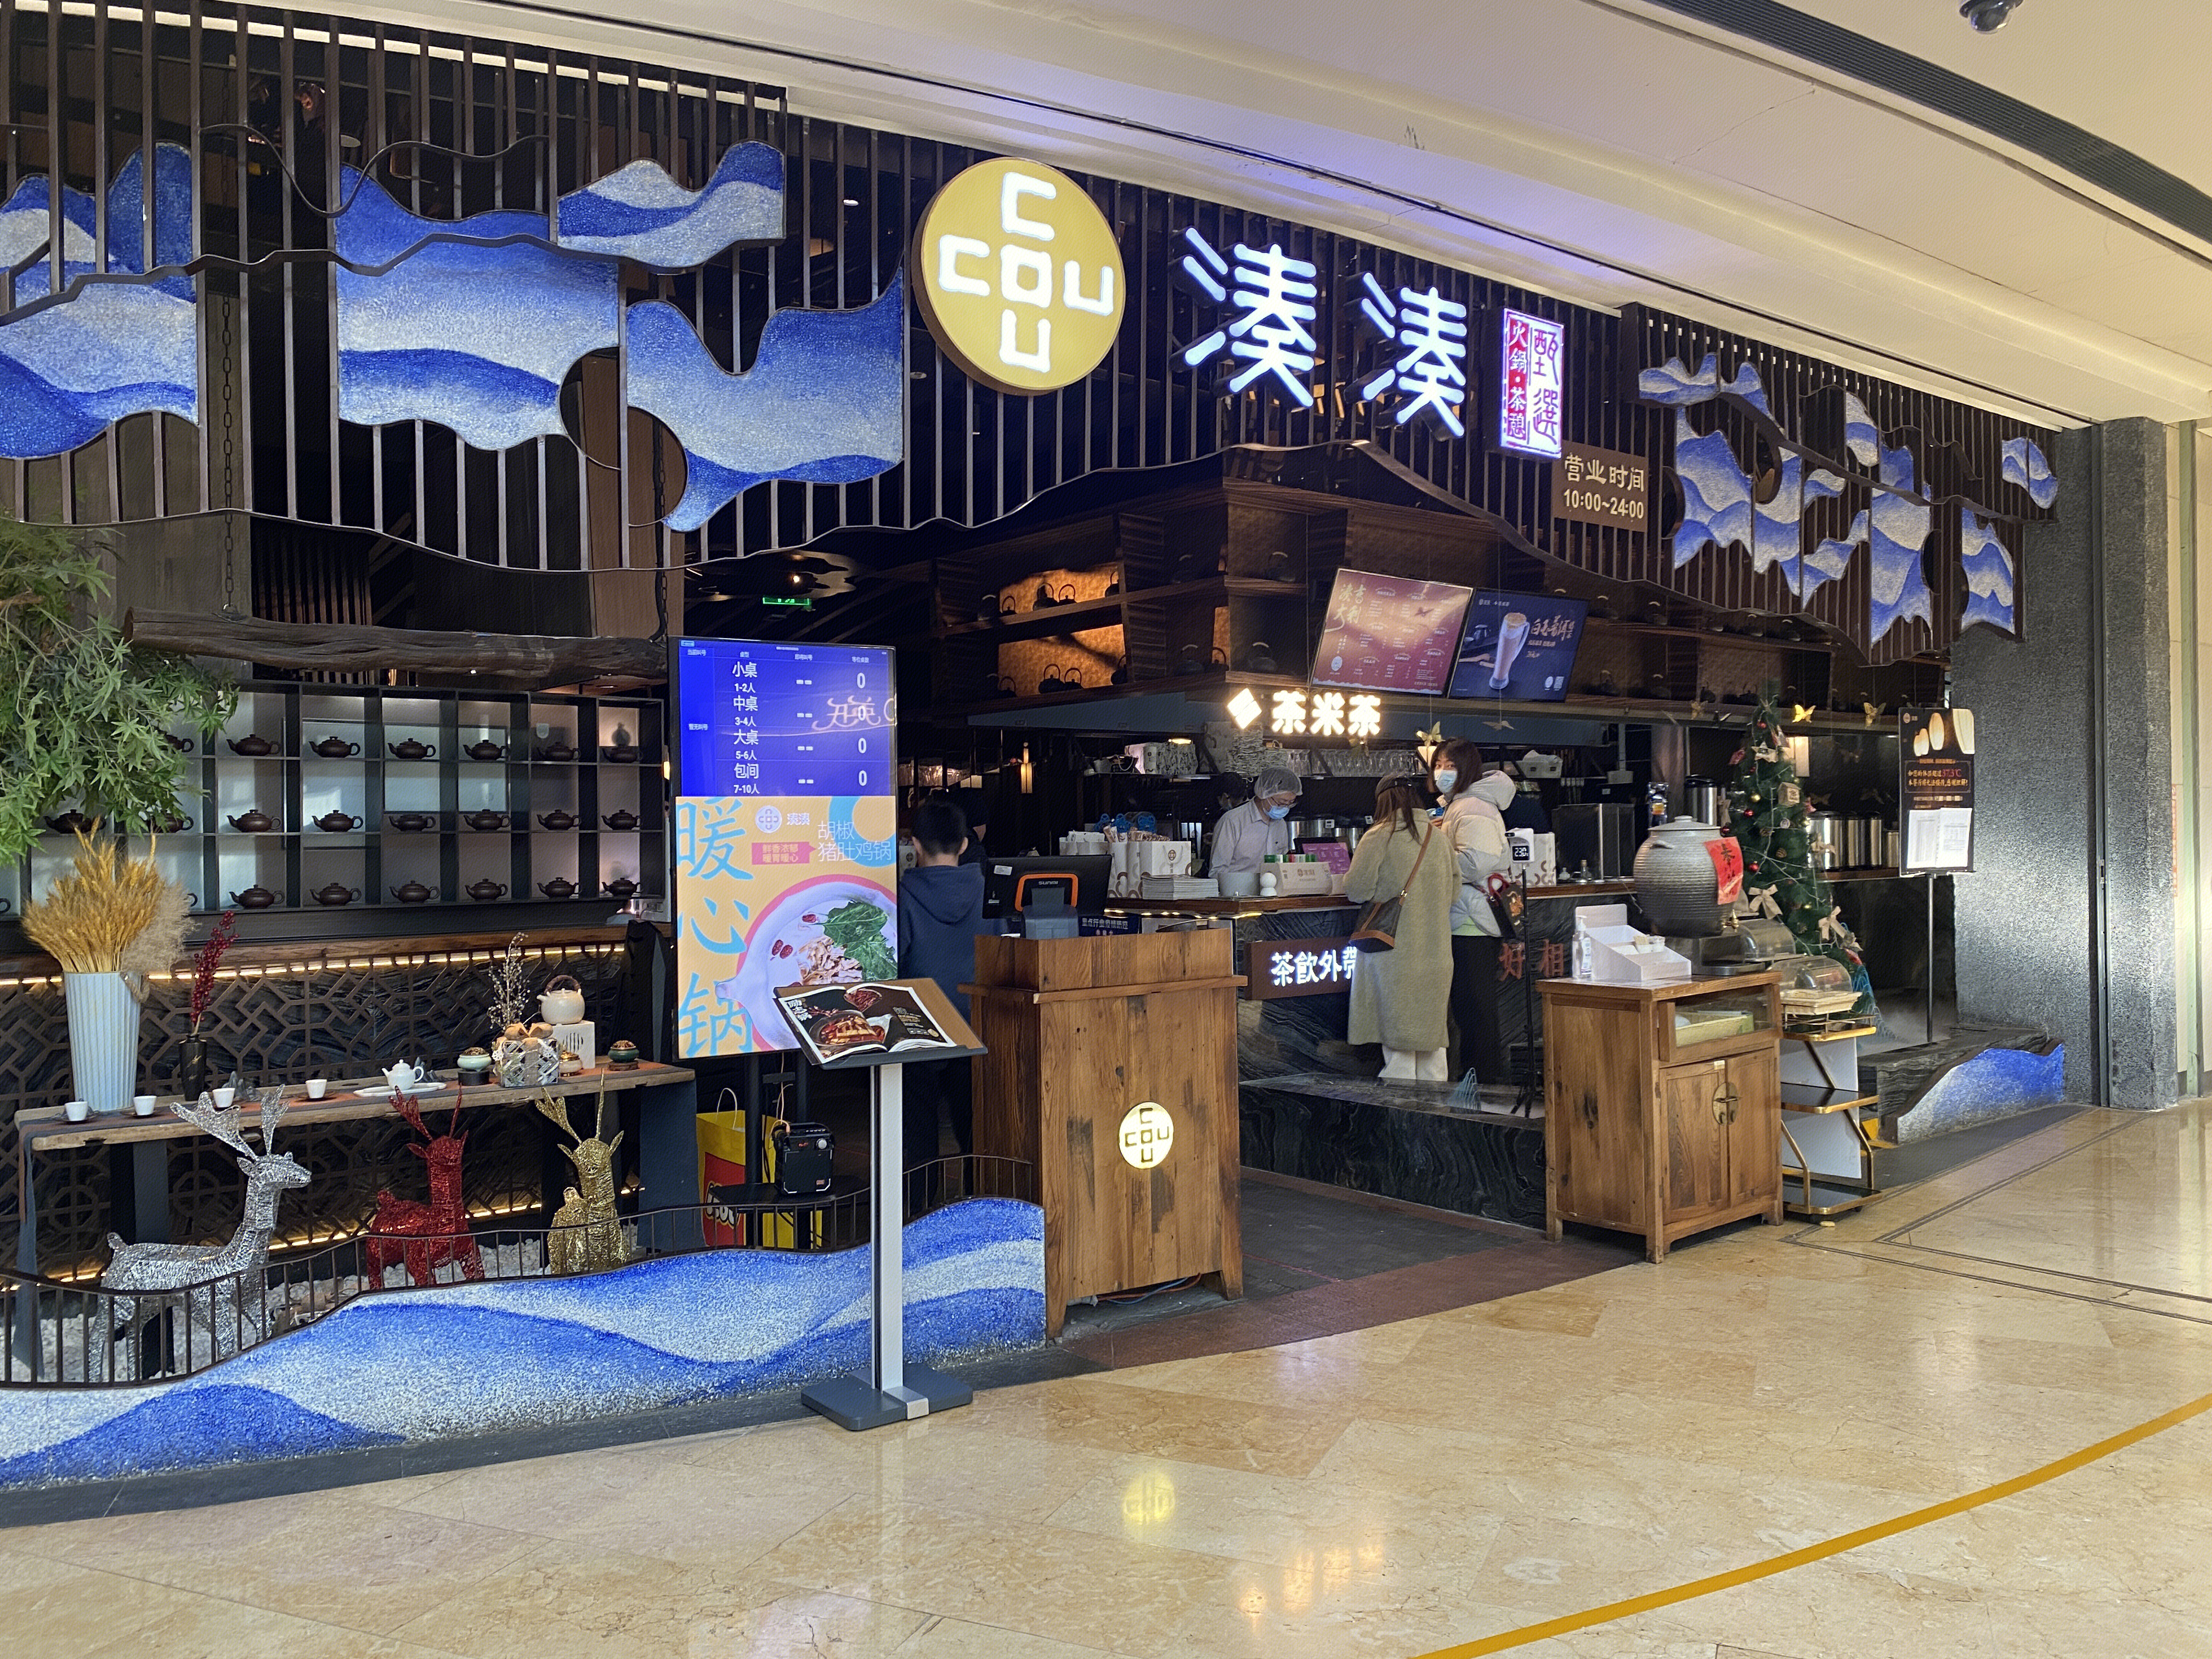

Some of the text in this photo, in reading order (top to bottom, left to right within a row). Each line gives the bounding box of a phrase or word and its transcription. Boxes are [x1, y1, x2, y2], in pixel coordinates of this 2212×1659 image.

[1565, 454, 1644, 492] 营业时间
[732, 662, 757, 678] 小桌
[735, 683, 755, 693] 1-2人
[857, 673, 865, 689] 0
[733, 696, 758, 711] 中桌
[858, 706, 866, 721] 0
[1272, 690, 1381, 736] 茶米茶
[735, 717, 756, 726] 3-4人
[733, 730, 758, 745] 大桌
[858, 738, 866, 753] 0
[736, 751, 757, 760] 5-6人
[734, 764, 759, 779] 包间
[859, 770, 867, 786] 0
[733, 785, 760, 794] 7-10人
[817, 821, 854, 840] 胡椒
[763, 844, 798, 853] 鲜香浓郁
[818, 841, 891, 861] 猪肚鸡锅
[763, 854, 798, 863] 暖胃暖心
